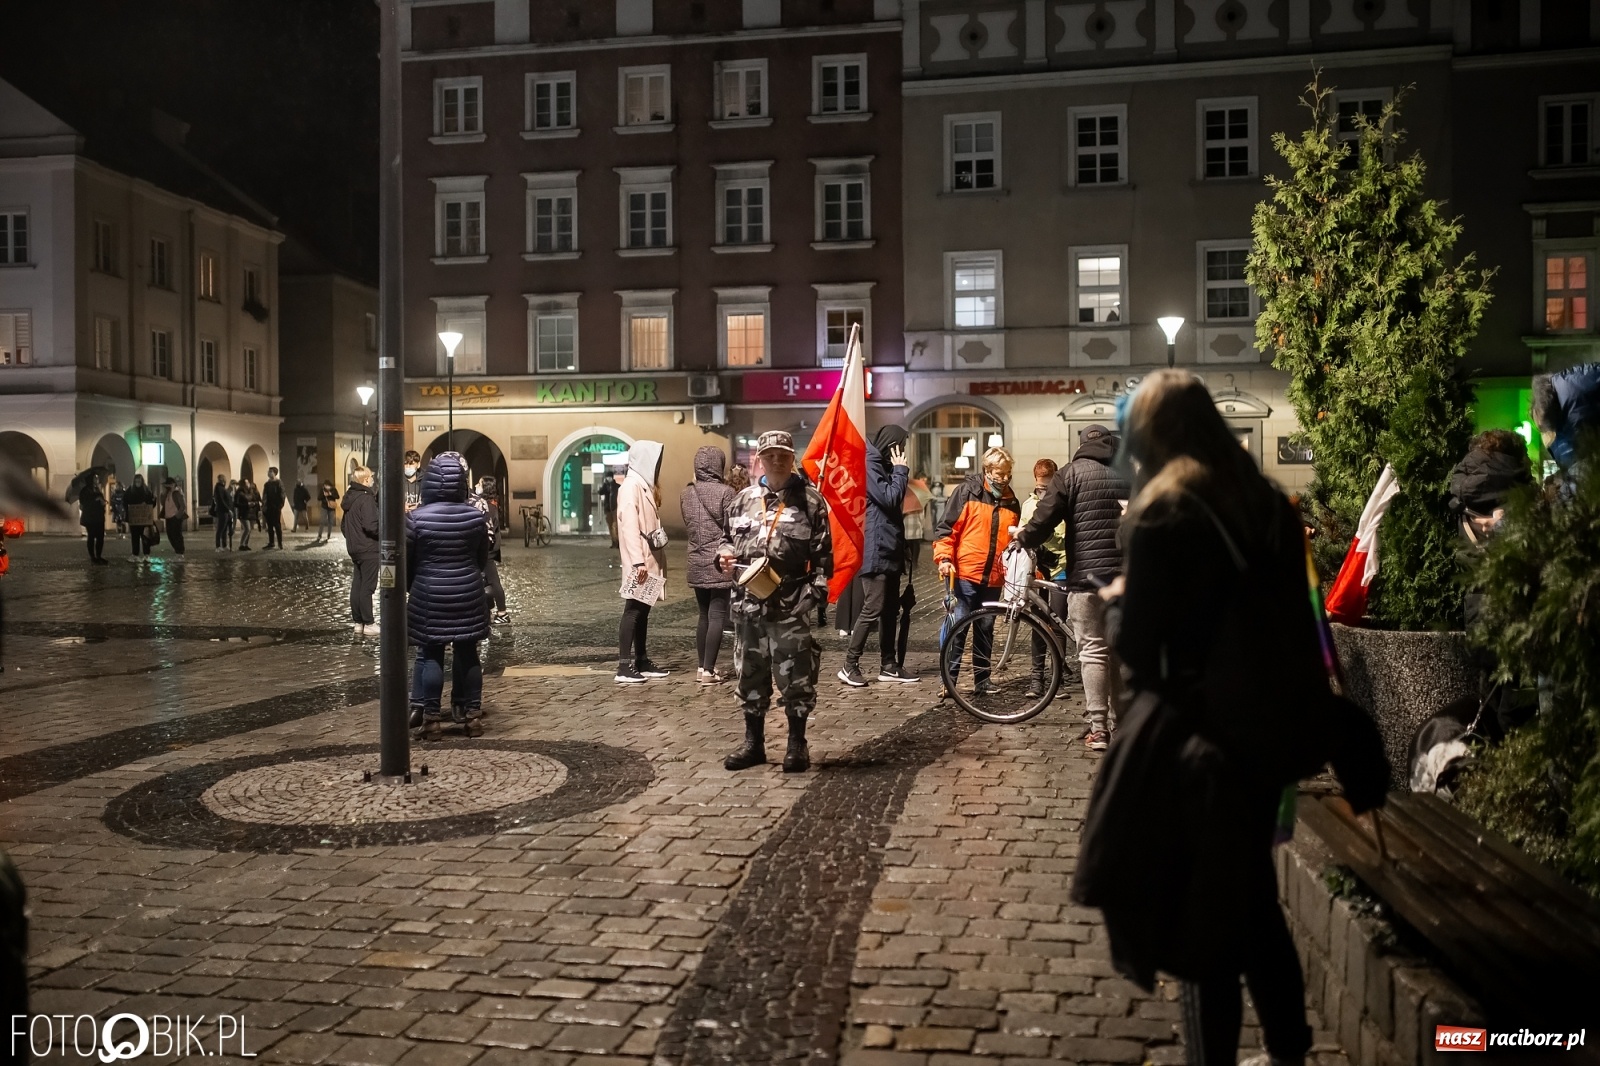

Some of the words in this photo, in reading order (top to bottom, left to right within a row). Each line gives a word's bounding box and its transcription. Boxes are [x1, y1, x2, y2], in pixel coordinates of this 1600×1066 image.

[418, 384, 500, 396] TABAC
[536, 381, 659, 403] KANTOR
[968, 379, 1087, 396] RESTAURACJA
[563, 462, 571, 519] KANTOR
